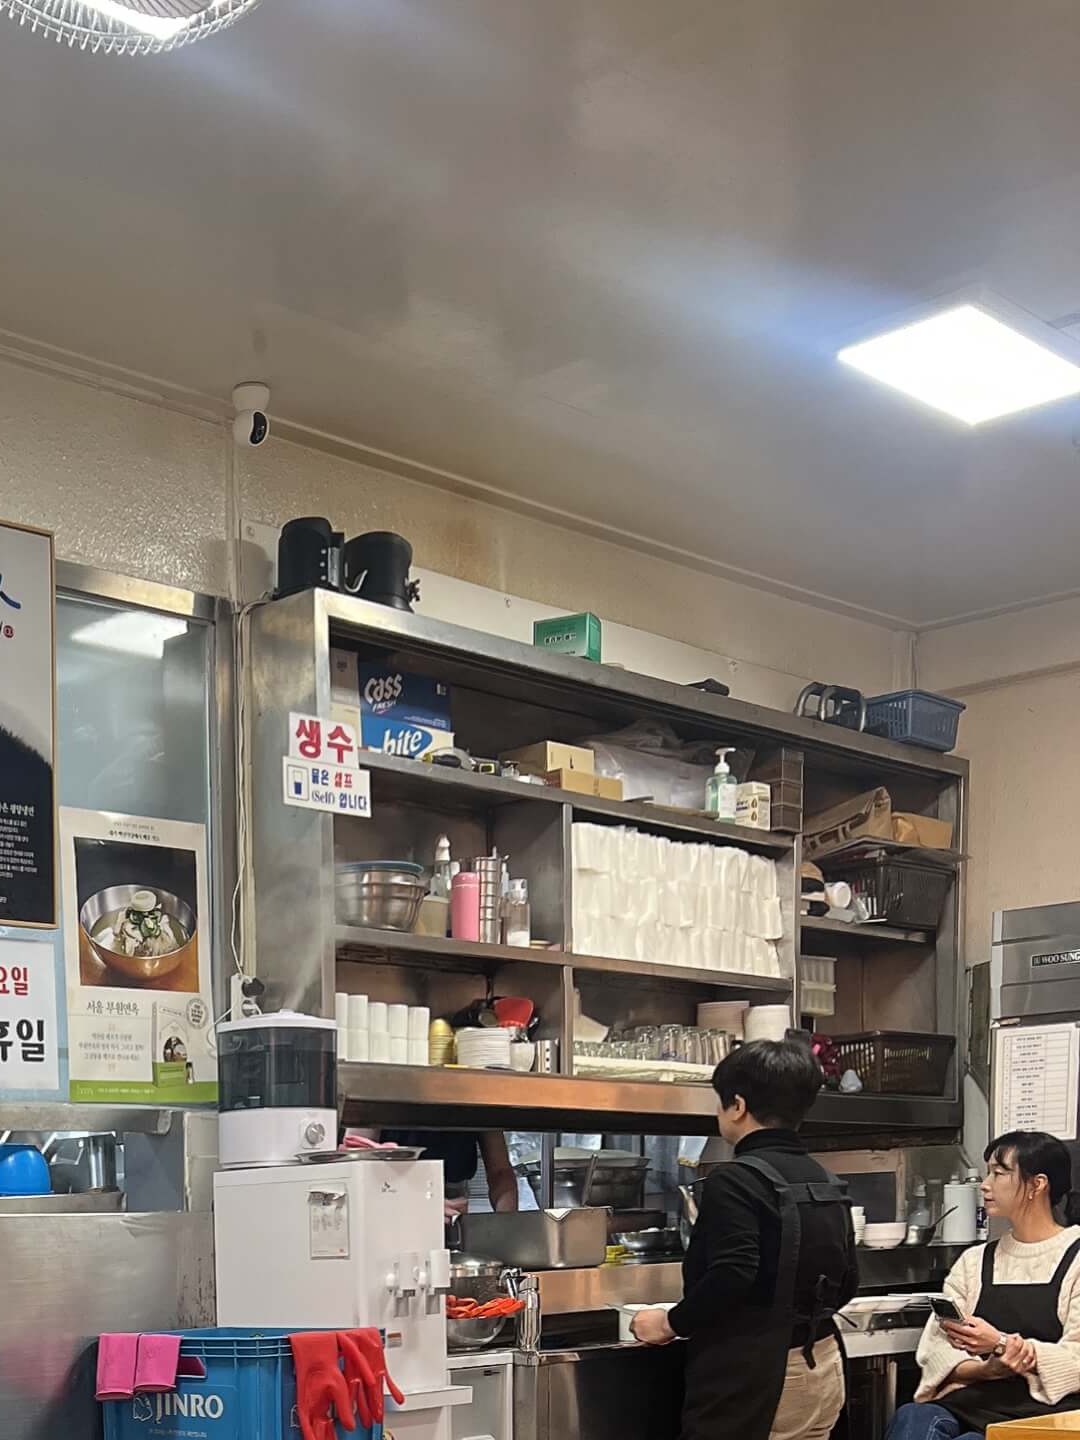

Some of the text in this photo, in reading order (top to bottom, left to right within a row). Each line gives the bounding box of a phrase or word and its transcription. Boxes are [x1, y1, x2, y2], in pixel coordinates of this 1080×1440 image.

[295, 719, 354, 764] 생수
[339, 792, 367, 811] 입니다
[106, 1001, 140, 1017] 부원면옥
[155, 1392, 224, 1424] JINRO
